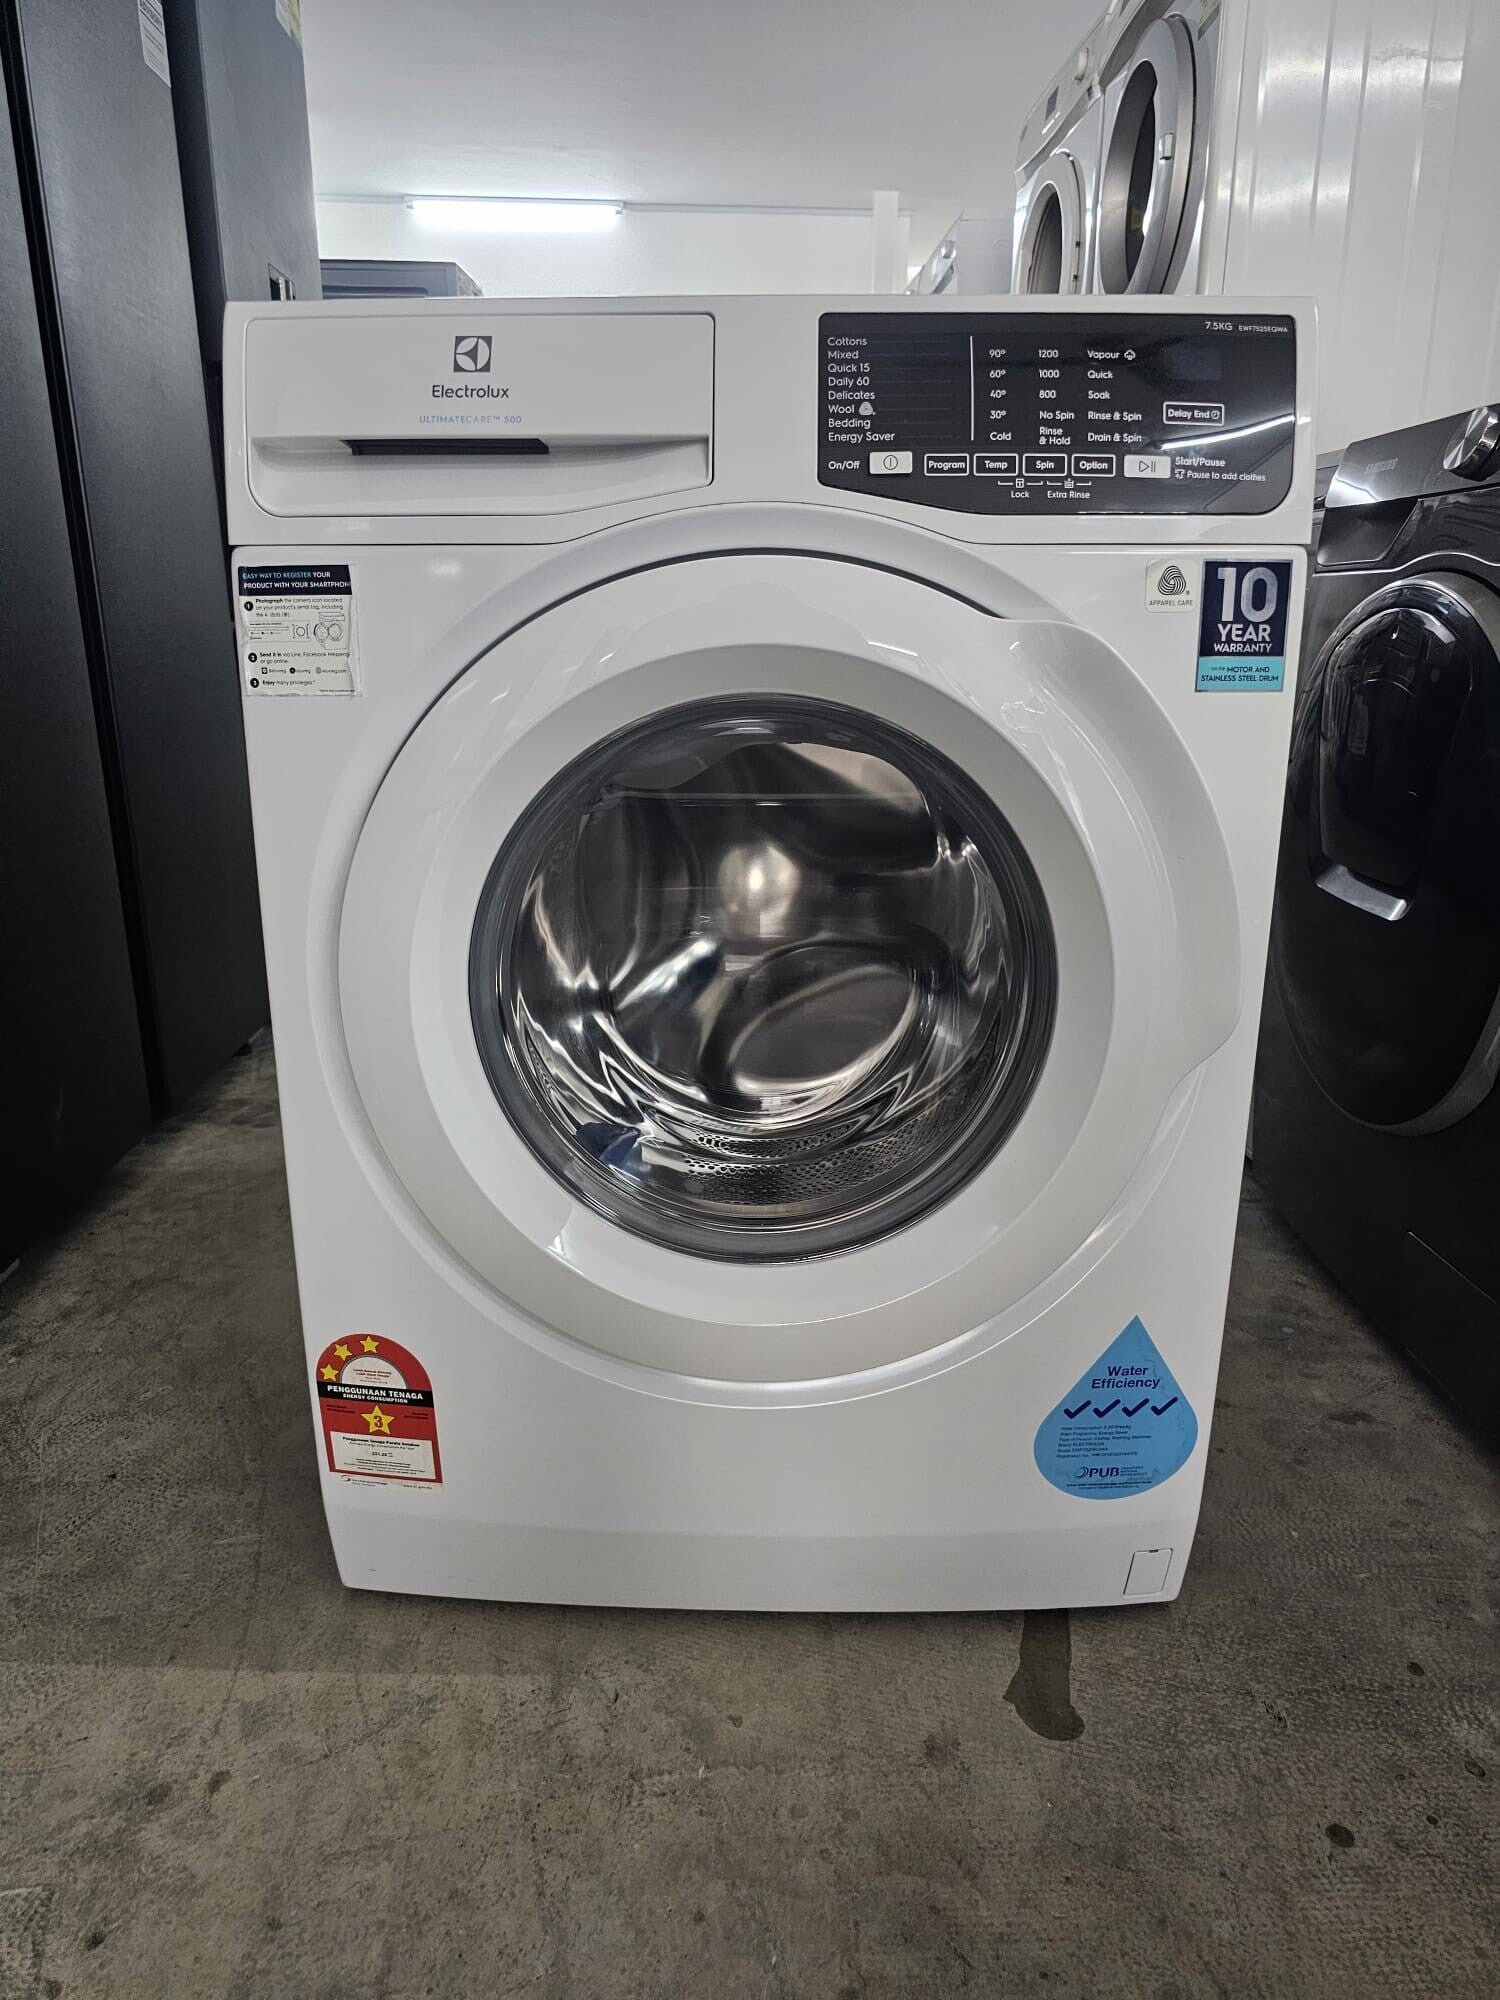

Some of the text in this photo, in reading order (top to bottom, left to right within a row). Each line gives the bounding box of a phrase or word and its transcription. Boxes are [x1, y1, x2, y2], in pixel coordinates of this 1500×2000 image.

[1204, 322, 1232, 331] 7.5KG
[827, 337, 868, 346] Cottons
[827, 350, 859, 359] Mixed
[1038, 350, 1059, 358] 1200
[1087, 350, 1120, 360] Vapour
[828, 363, 870, 373] Quick 15
[1038, 370, 1060, 378] 1000
[1087, 370, 1114, 379] Quick
[828, 377, 870, 388] Daily 60
[431, 384, 509, 398] Electrolux
[828, 391, 875, 400] Delicates
[1038, 390, 1056, 398] 800
[1087, 391, 1111, 399] Soak
[827, 404, 855, 414] Wool
[1168, 409, 1210, 419] Delay End
[503, 416, 522, 424] 500
[1039, 411, 1075, 421] No Spin
[1087, 411, 1142, 422] Rinse & Spin
[828, 418, 871, 429] Bedding
[1039, 426, 1063, 435] Rinse
[828, 432, 895, 443] Energy Saver
[990, 432, 1011, 441] Cold
[1039, 436, 1071, 445] & Hold
[1087, 432, 1142, 444] Drain & Spin
[828, 460, 860, 470] On/Off
[928, 460, 965, 470] Program
[984, 460, 1008, 470] Temp
[1035, 460, 1054, 470] Spin
[1079, 460, 1108, 470] Option
[1175, 456, 1226, 467] Start/Pause
[1187, 471, 1266, 481] Pause to add clothes
[1047, 491, 1090, 499] Extra Rinse
[1217, 566, 1278, 623] 10
[1217, 624, 1271, 642] YEAR
[1213, 643, 1272, 653] WARRANTY
[1107, 1366, 1148, 1376] Water
[1092, 1378, 1160, 1389] Efficiency
[327, 1385, 423, 1400] PENGGUNAAN TENAGA
[366, 1395, 408, 1404] CONSUMPTION
[374, 1416, 383, 1428] 3
[1088, 1467, 1120, 1478] PUB
